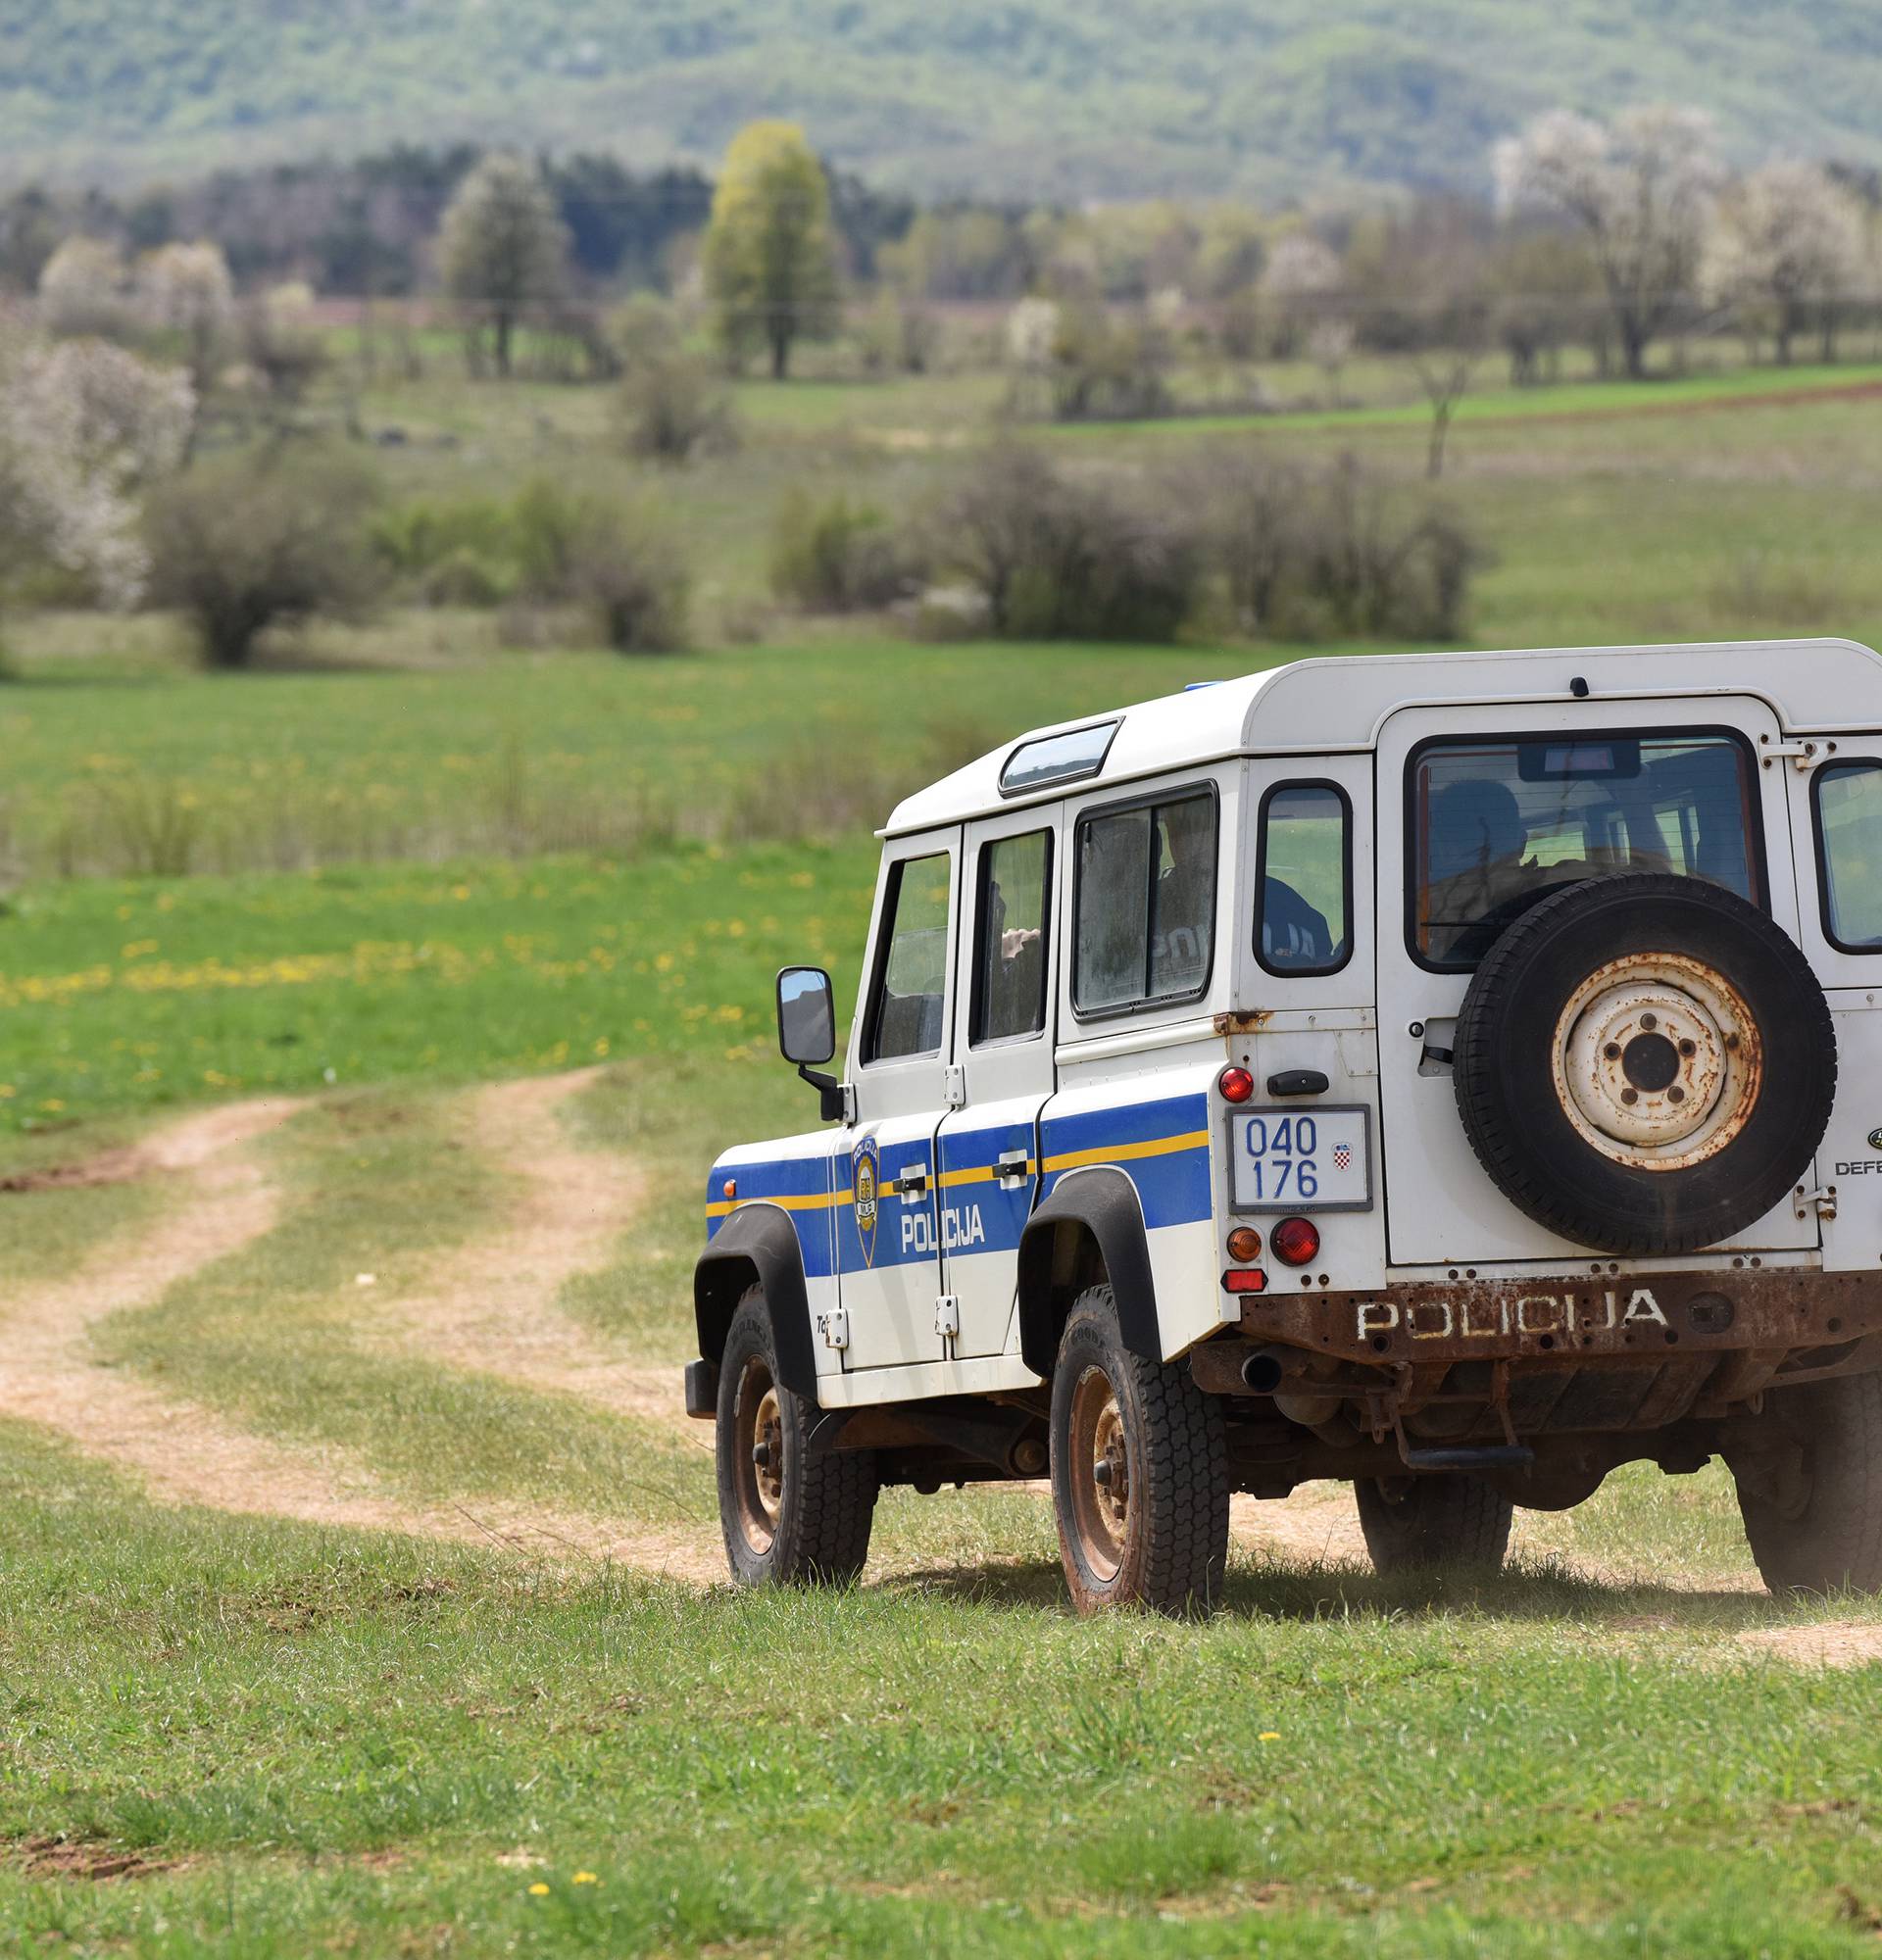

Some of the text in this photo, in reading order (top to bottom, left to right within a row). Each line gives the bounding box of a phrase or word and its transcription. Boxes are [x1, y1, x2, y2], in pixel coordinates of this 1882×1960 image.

[1246, 1116, 1317, 1158] 040
[1253, 1158, 1318, 1200] 176
[901, 1203, 985, 1253] POLICIJA
[1357, 1288, 1668, 1341] POLICIJA
